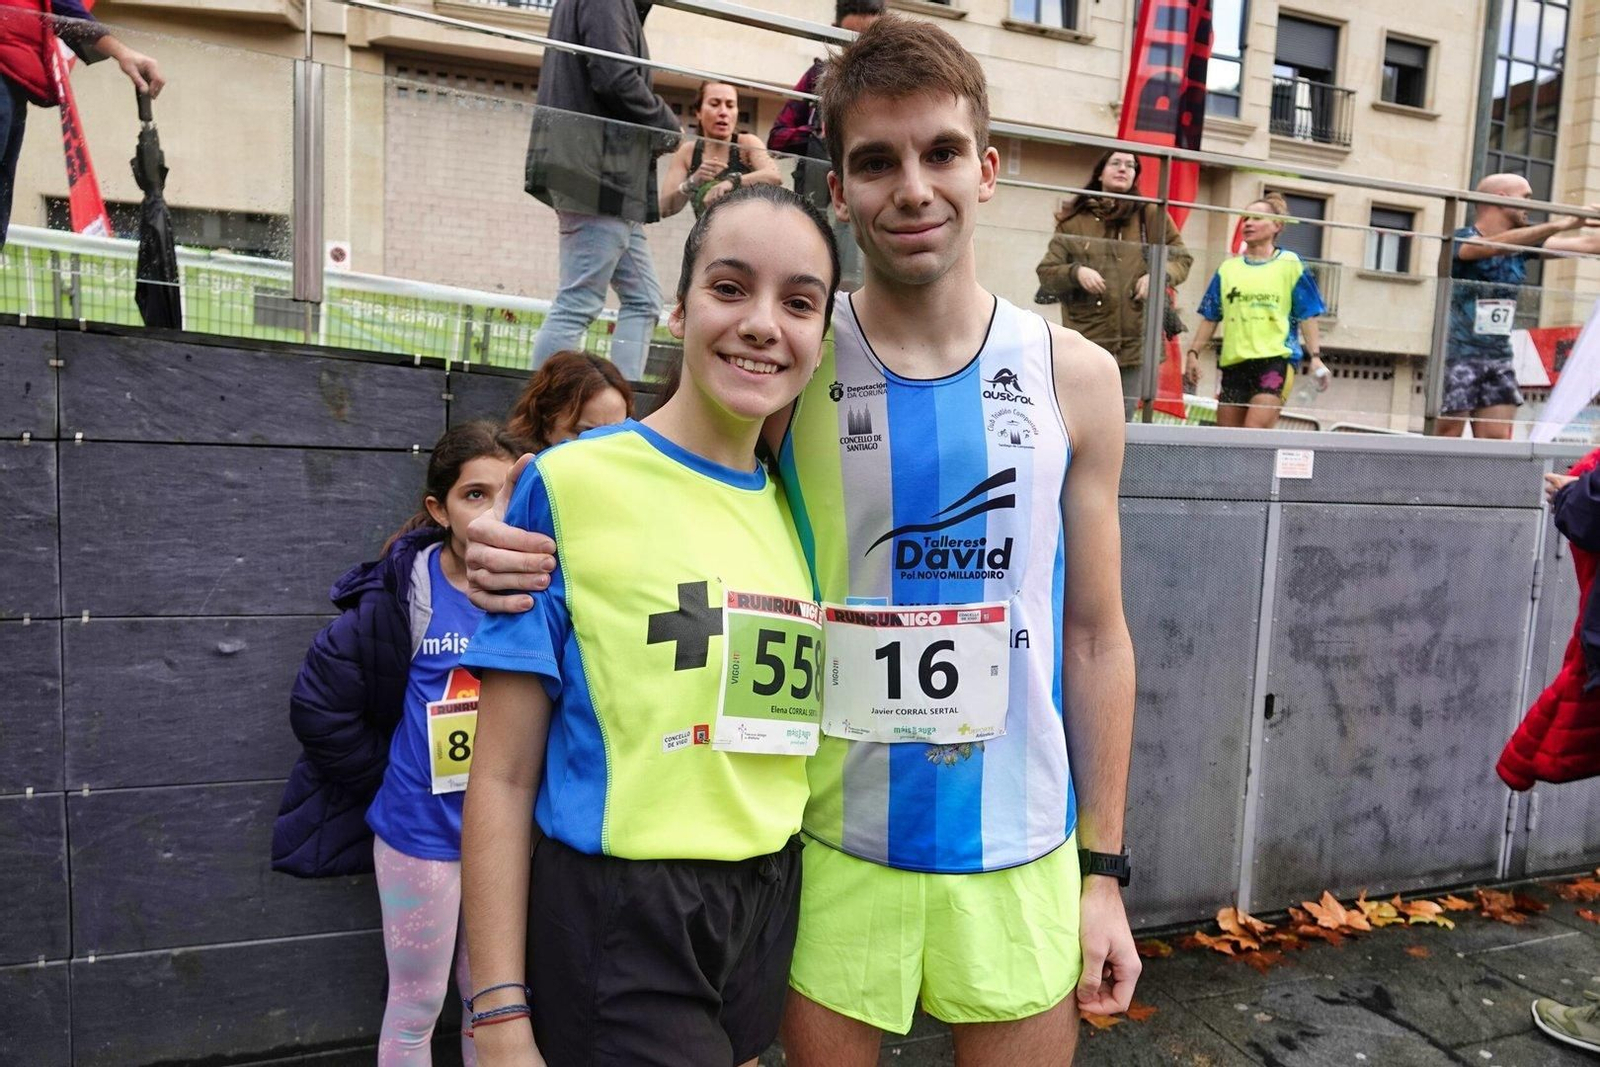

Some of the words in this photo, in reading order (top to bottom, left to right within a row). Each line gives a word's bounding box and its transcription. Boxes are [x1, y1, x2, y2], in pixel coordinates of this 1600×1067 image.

[1491, 307, 1510, 323] 67
[846, 382, 888, 393] Deputación
[982, 390, 1035, 406] austral
[839, 435, 873, 445] CONCELLO
[873, 434, 882, 442] DE
[846, 442, 878, 452] SANTIAGO
[923, 535, 979, 548] Talleres
[895, 537, 1014, 570] David
[875, 639, 960, 700] 16
[437, 701, 478, 715] RUNRU
[770, 705, 788, 714] Elena
[788, 707, 808, 716] CORRAL
[871, 707, 894, 715] Javier
[895, 708, 928, 716] CORRAL
[930, 707, 959, 715] SERTAL
[664, 730, 691, 743] CONCELLO
[448, 730, 471, 762] 8
